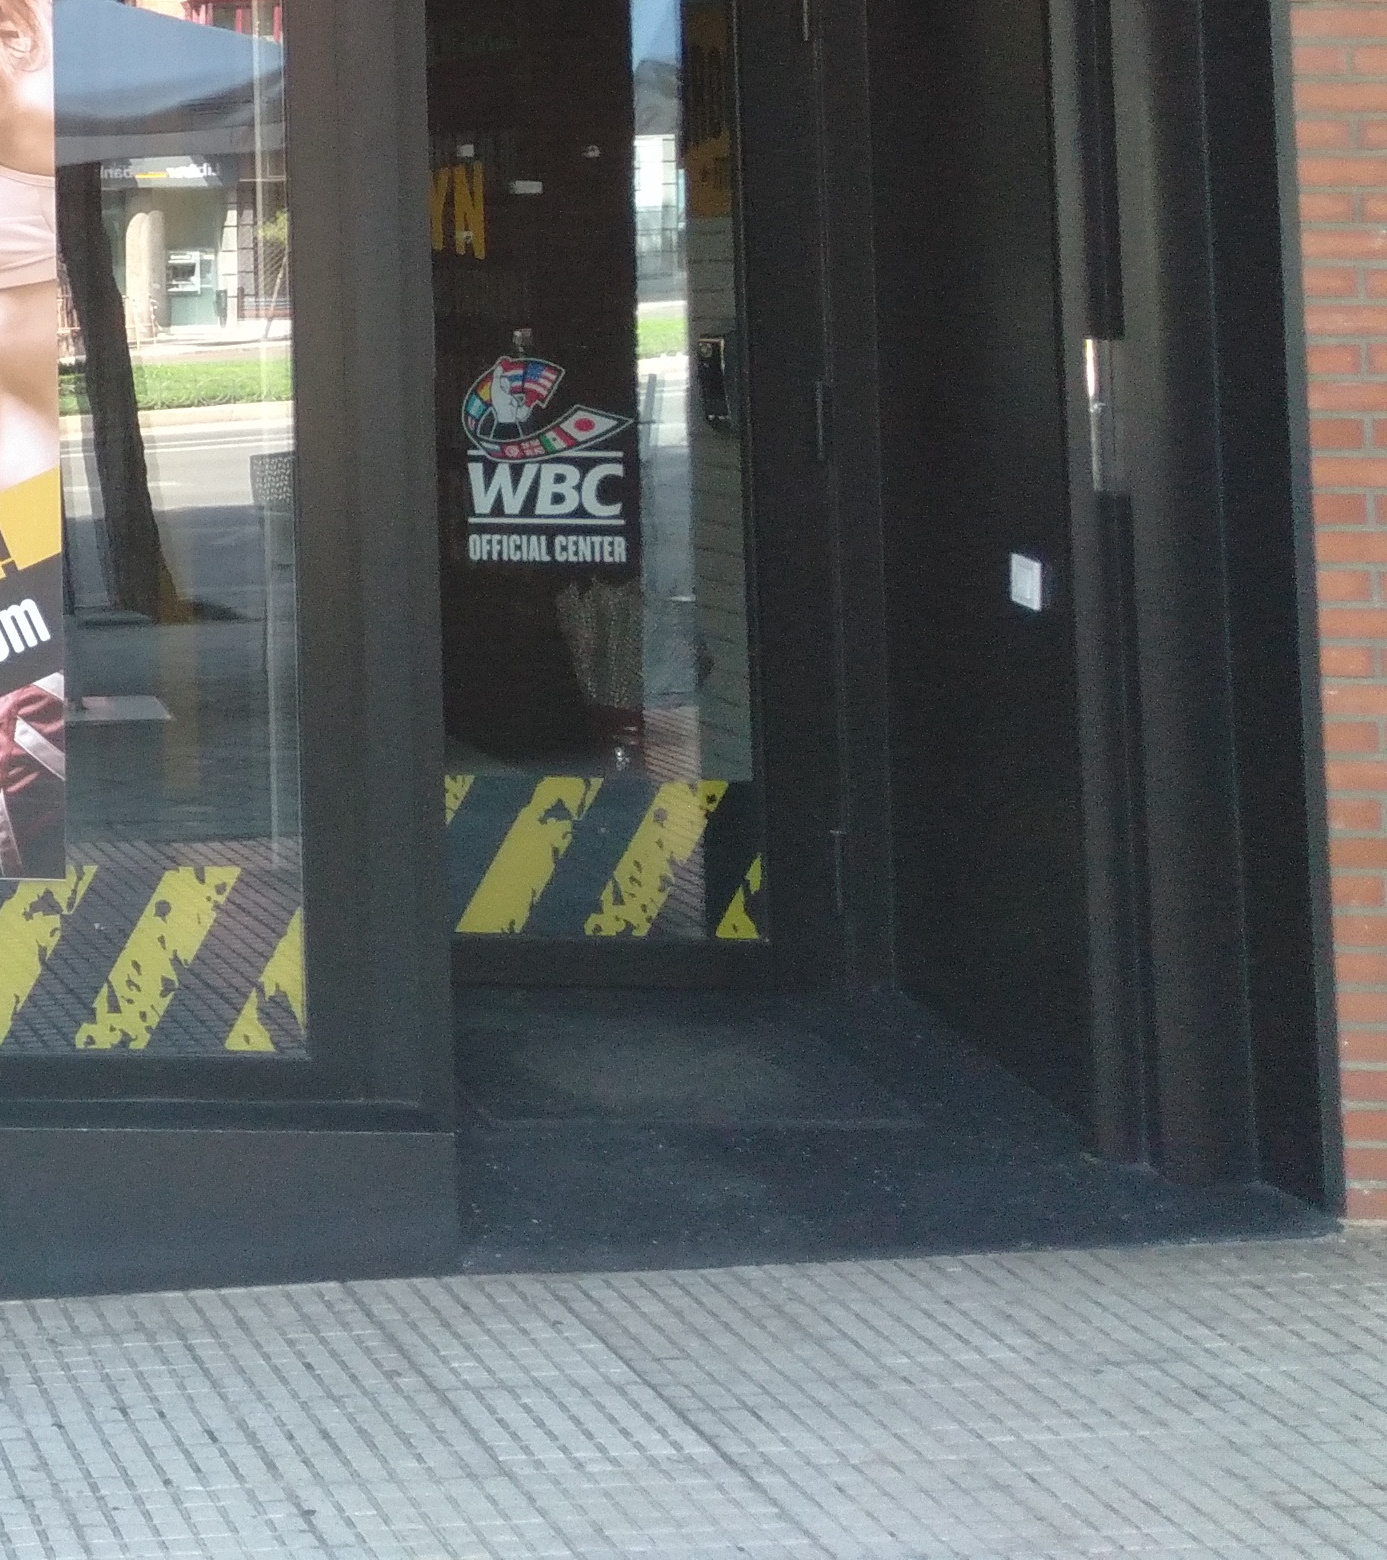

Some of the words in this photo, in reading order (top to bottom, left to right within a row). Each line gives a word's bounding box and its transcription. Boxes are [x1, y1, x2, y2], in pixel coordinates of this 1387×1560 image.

[467, 461, 624, 518] WBC
[468, 532, 551, 563] OFFICIAL
[554, 532, 628, 563] CENTER
